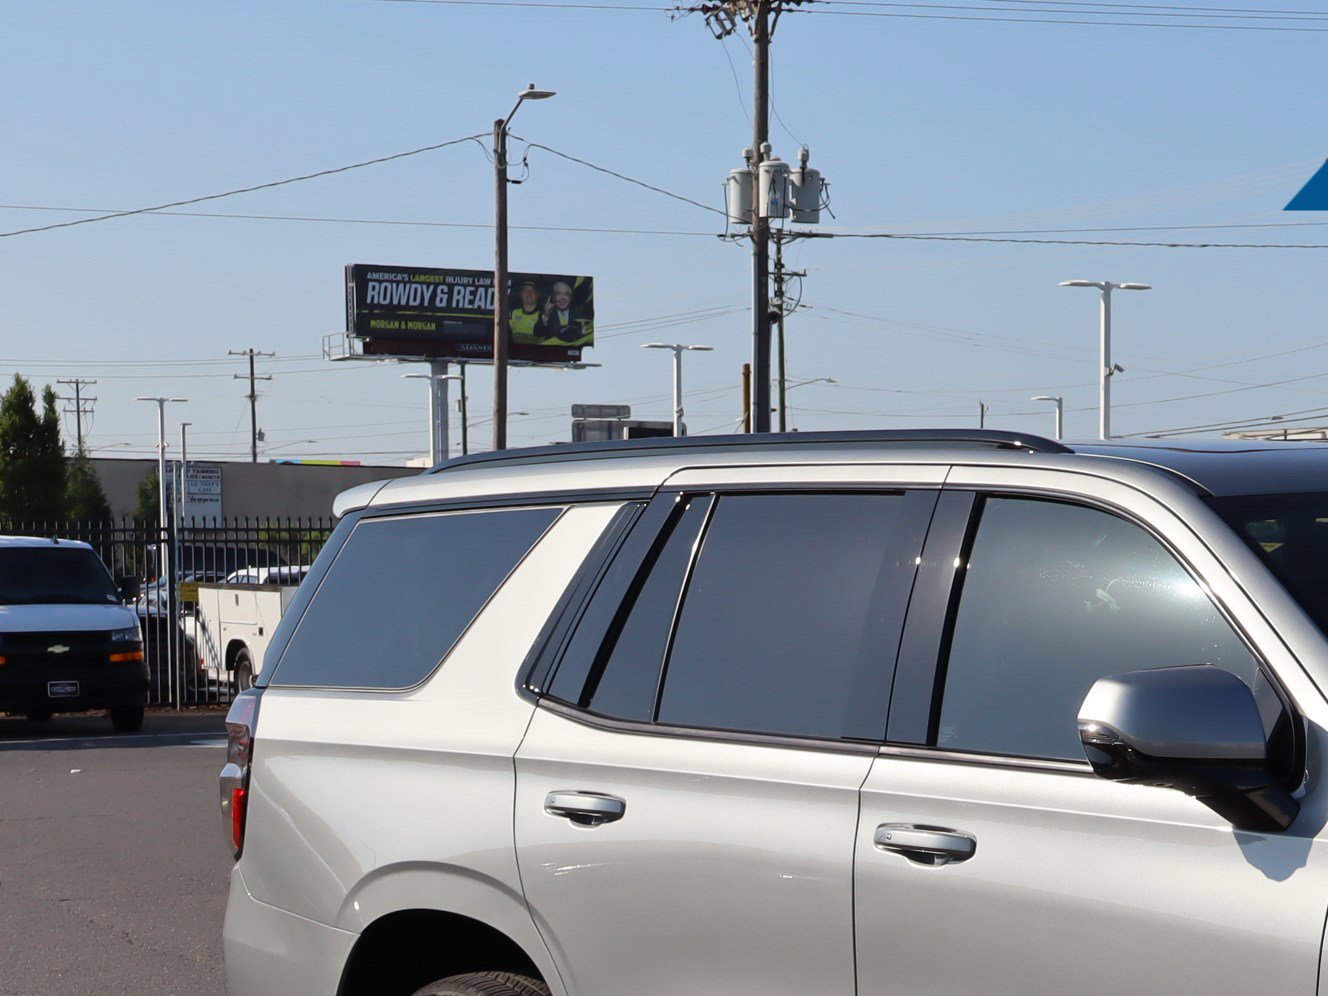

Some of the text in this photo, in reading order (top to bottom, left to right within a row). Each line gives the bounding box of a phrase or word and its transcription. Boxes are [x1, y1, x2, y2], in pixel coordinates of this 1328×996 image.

[367, 272, 409, 281] AMERICA'S
[410, 274, 444, 282] LARGEST
[445, 275, 473, 284] INJURY
[475, 277, 491, 285] LAW
[366, 281, 511, 309] ROWDY & READ
[370, 319, 399, 329] MORGAN
[407, 321, 436, 331] MORGAN
